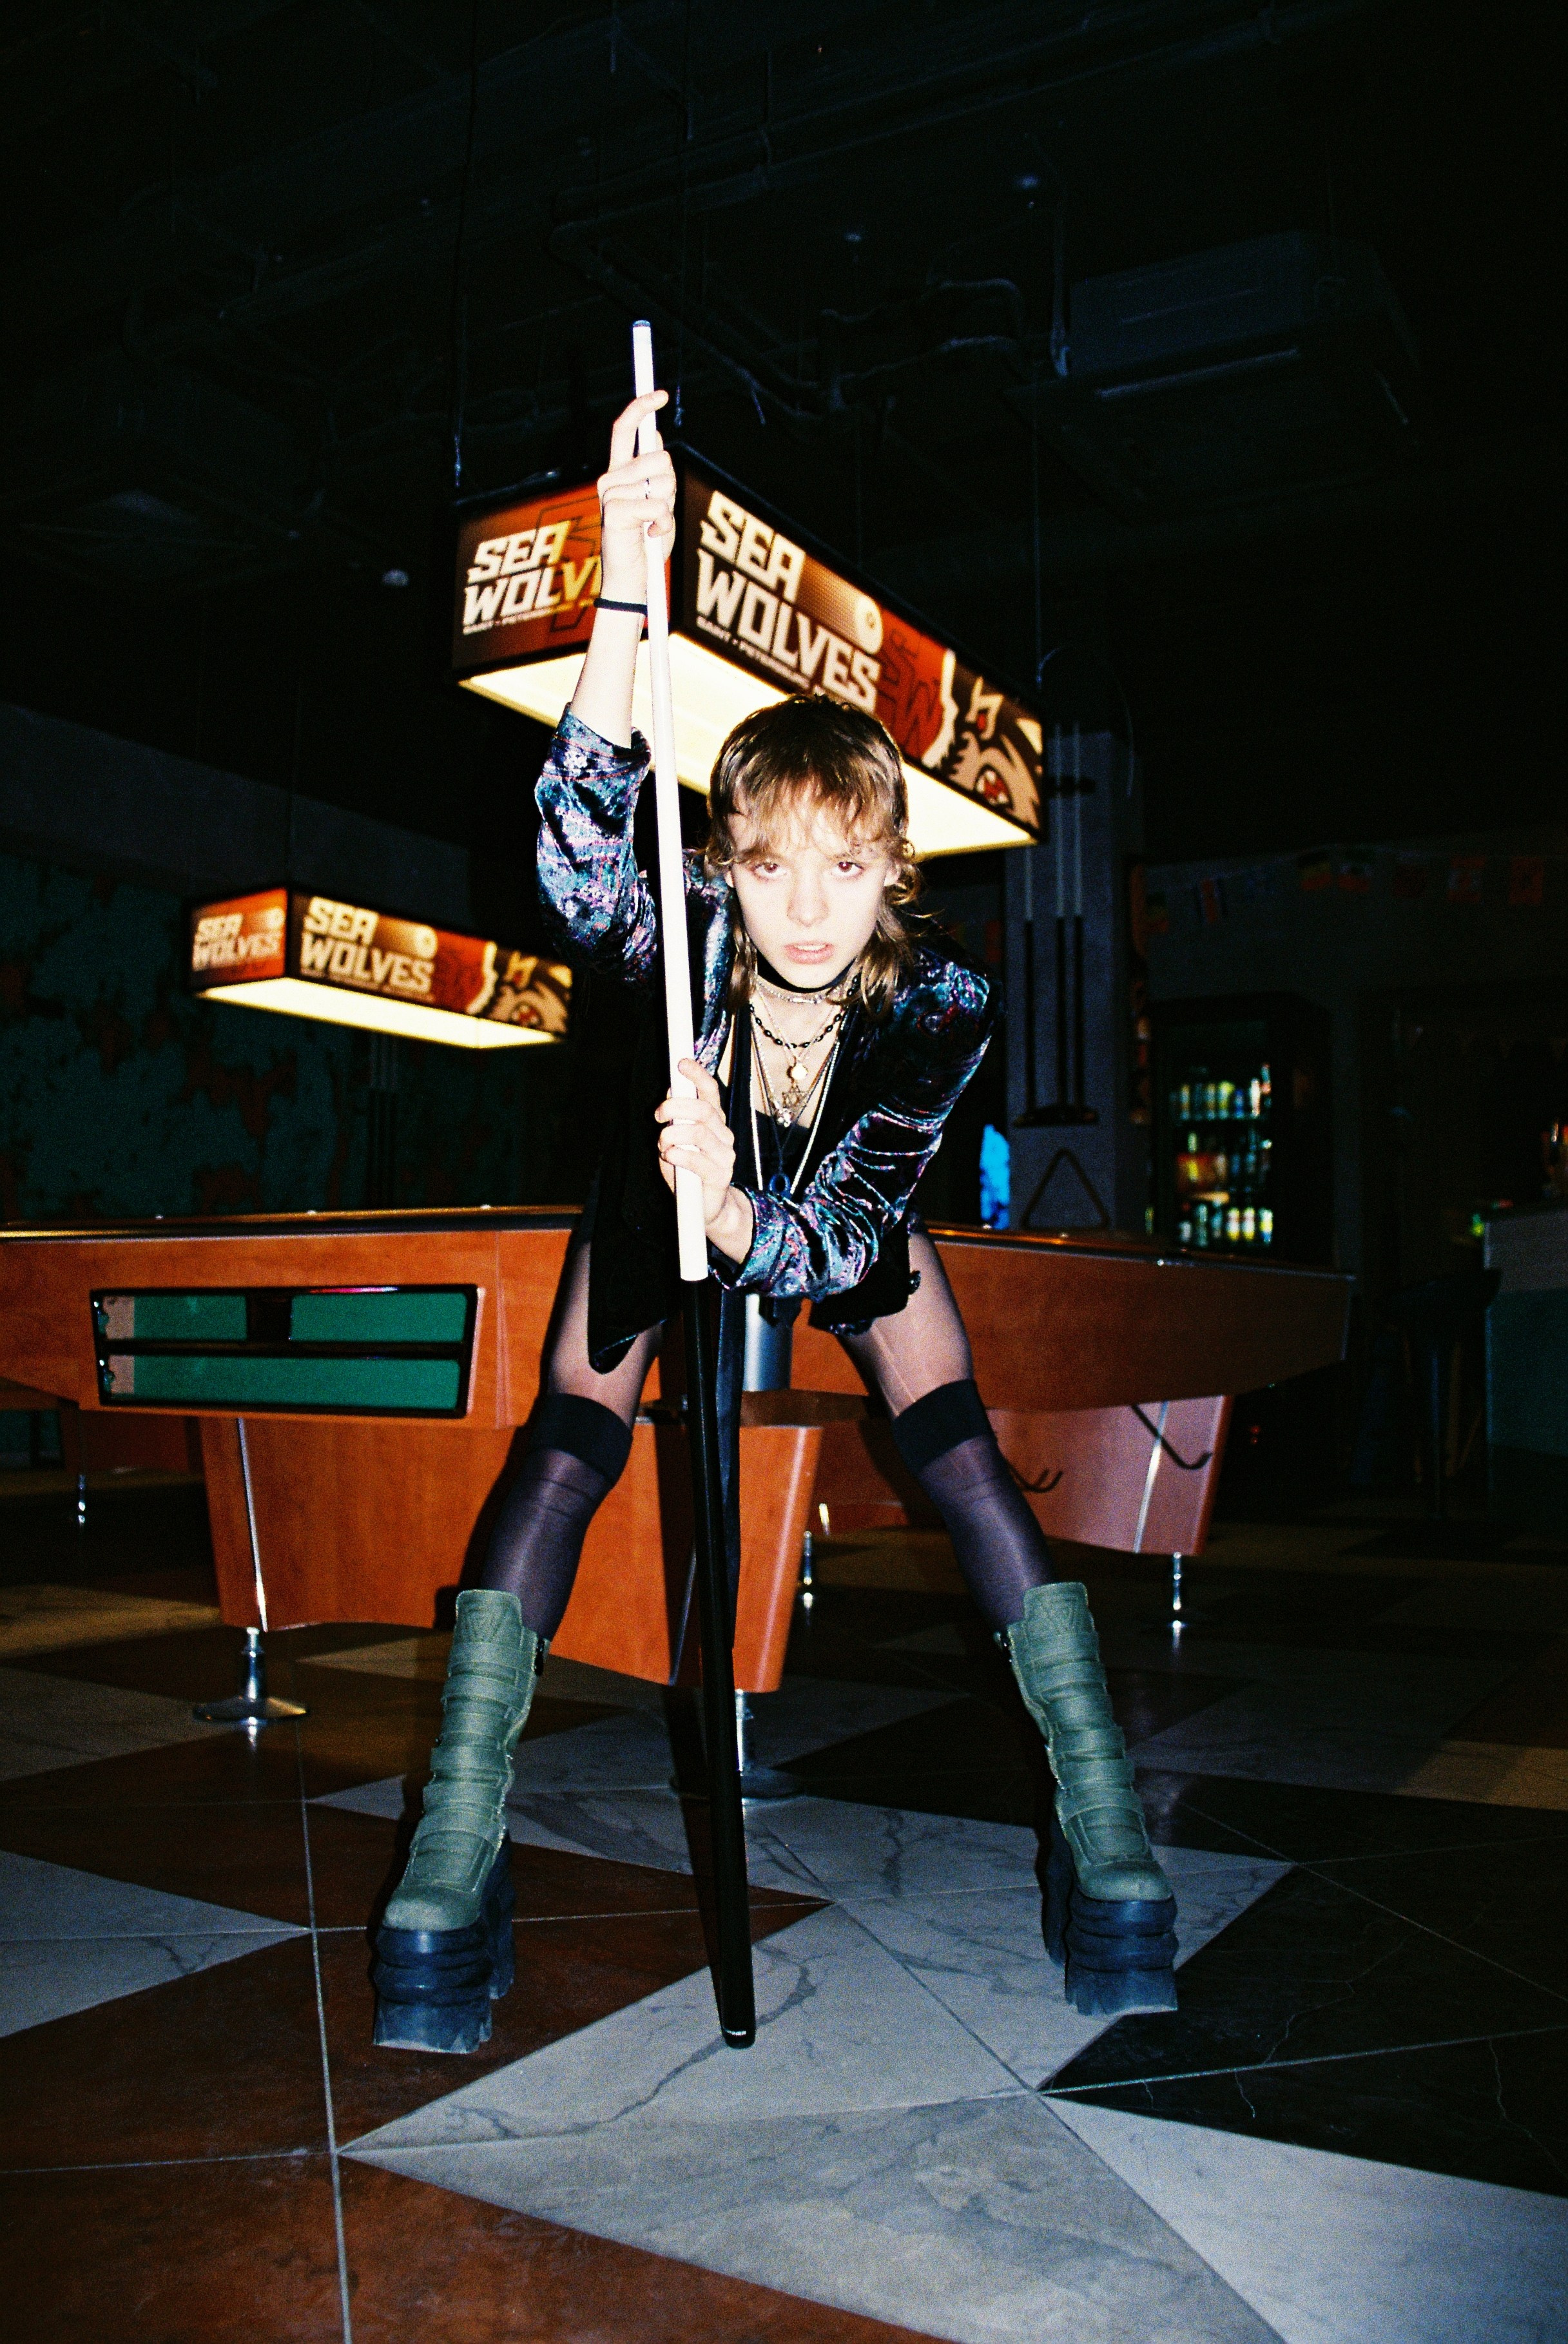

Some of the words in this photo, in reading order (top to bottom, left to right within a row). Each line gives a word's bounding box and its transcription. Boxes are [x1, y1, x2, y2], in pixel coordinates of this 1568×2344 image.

[467, 519, 571, 585] SEA
[701, 490, 806, 601] SEA
[463, 555, 601, 625] WOLV
[696, 548, 880, 713] WOLVES
[193, 932, 283, 971] WOLVES
[195, 913, 243, 946] SEA
[304, 896, 379, 945] SEA
[300, 931, 434, 993] WOLVES
